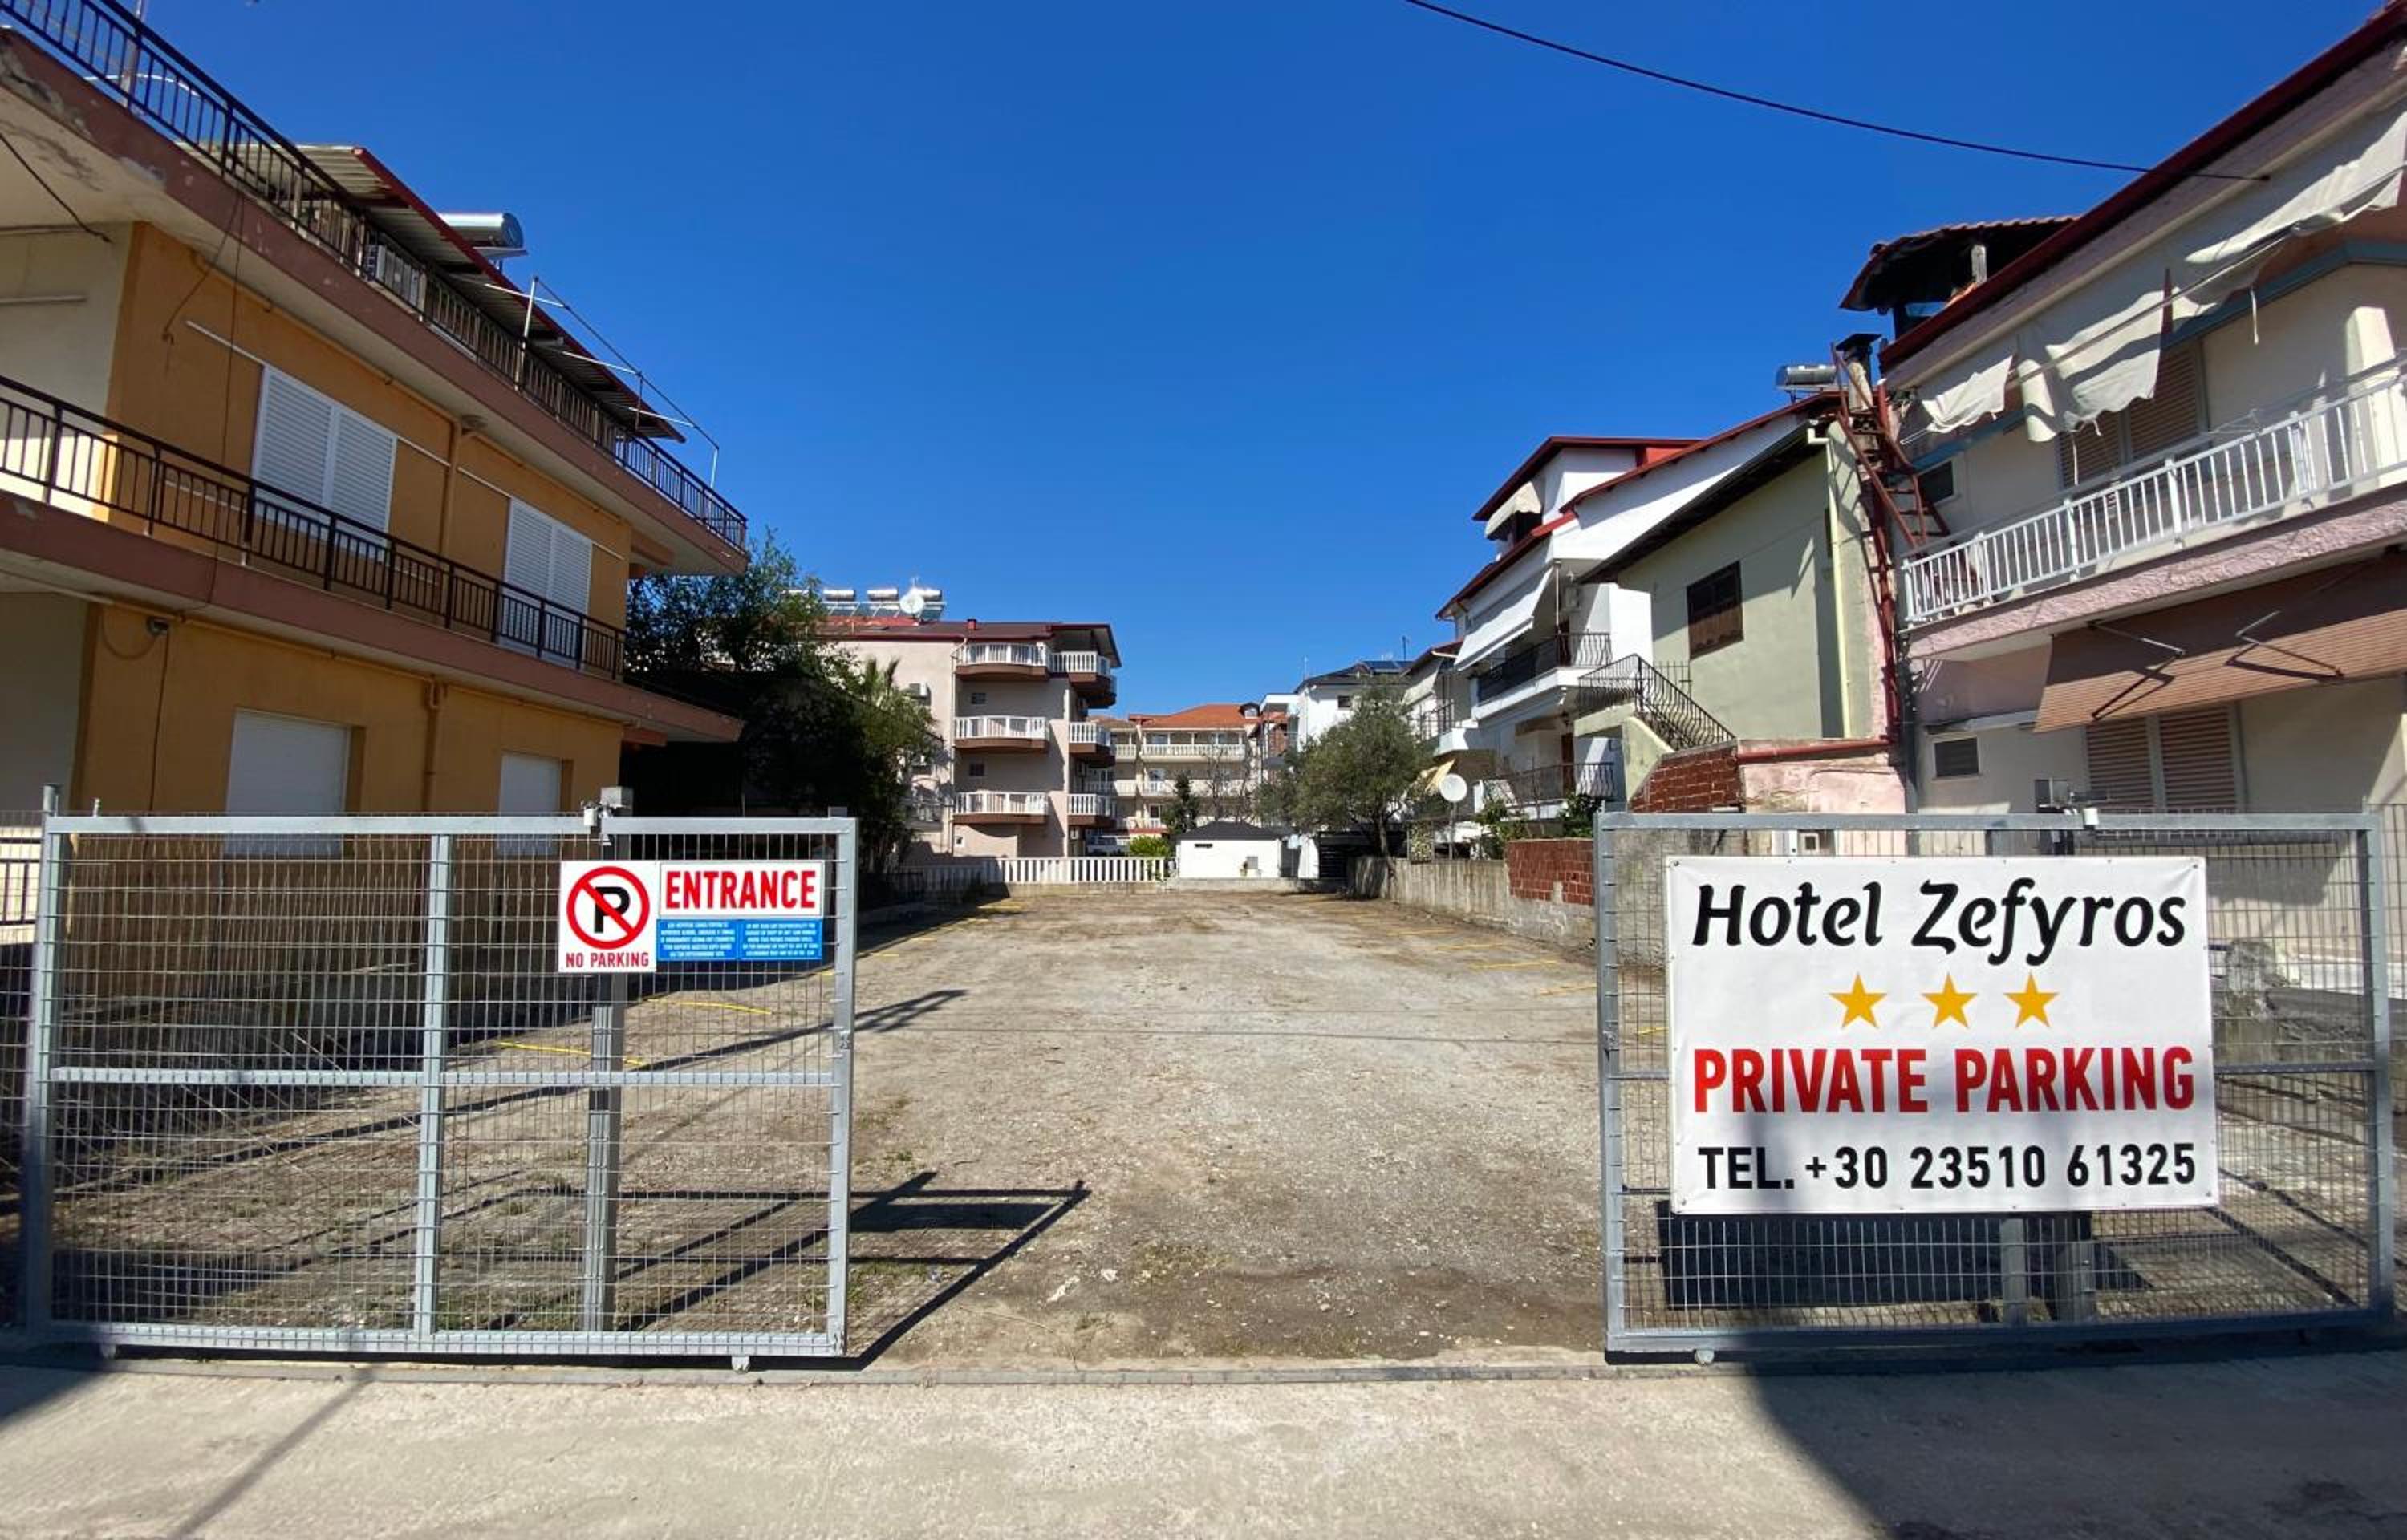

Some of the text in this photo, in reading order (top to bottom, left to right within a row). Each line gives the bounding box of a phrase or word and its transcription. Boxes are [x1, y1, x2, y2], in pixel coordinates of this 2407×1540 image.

[594, 886, 631, 934] P
[666, 871, 816, 909] ENTRANCE
[1692, 877, 2186, 966] Hotel Zefyros
[566, 952, 649, 968] NO PARKING
[1694, 1046, 2194, 1112] PRIVATE PARKING
[1910, 1145, 2046, 1189] 23510
[2067, 1143, 2195, 1187] 61325
